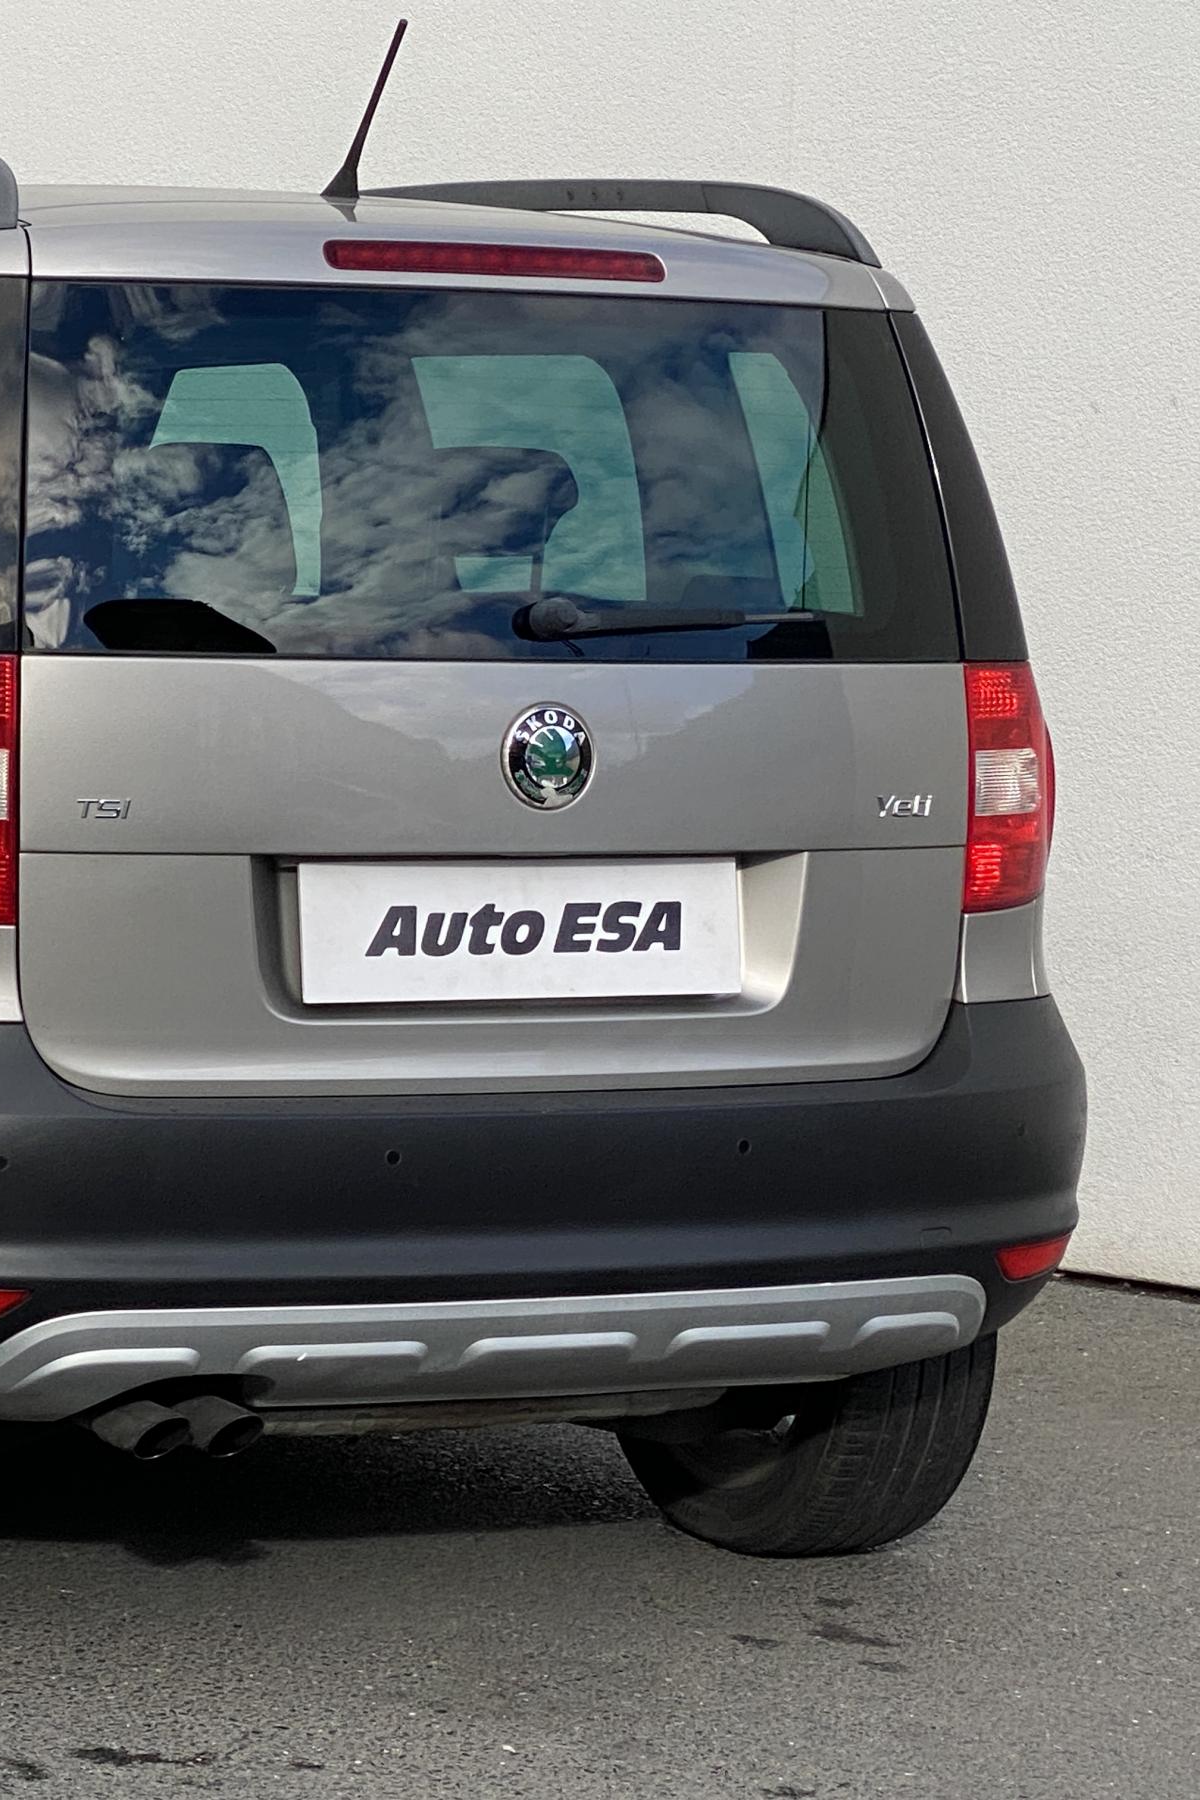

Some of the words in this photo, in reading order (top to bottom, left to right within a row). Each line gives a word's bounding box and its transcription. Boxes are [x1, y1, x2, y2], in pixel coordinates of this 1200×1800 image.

[76, 798, 131, 820] TSI
[877, 795, 933, 818] Yeti
[365, 903, 545, 957] Auto
[553, 901, 682, 954] ESA
